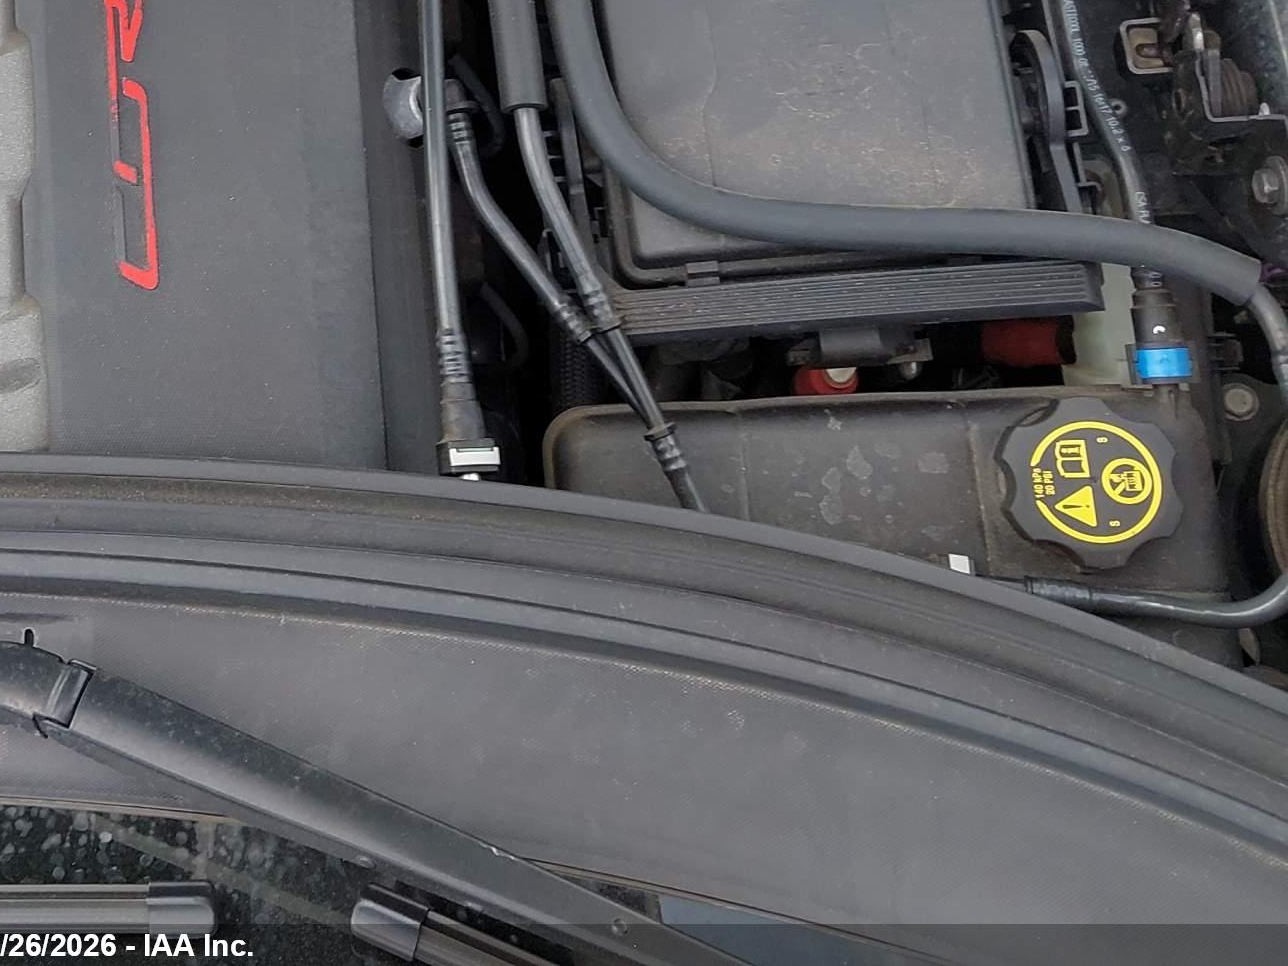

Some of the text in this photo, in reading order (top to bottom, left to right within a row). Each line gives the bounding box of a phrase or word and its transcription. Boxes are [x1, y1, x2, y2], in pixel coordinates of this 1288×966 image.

[1072, 37, 1086, 56] 1000
[1104, 116, 1123, 136] 10.2
[1043, 470, 1054, 483] PSI
[1033, 484, 1045, 498] 140
